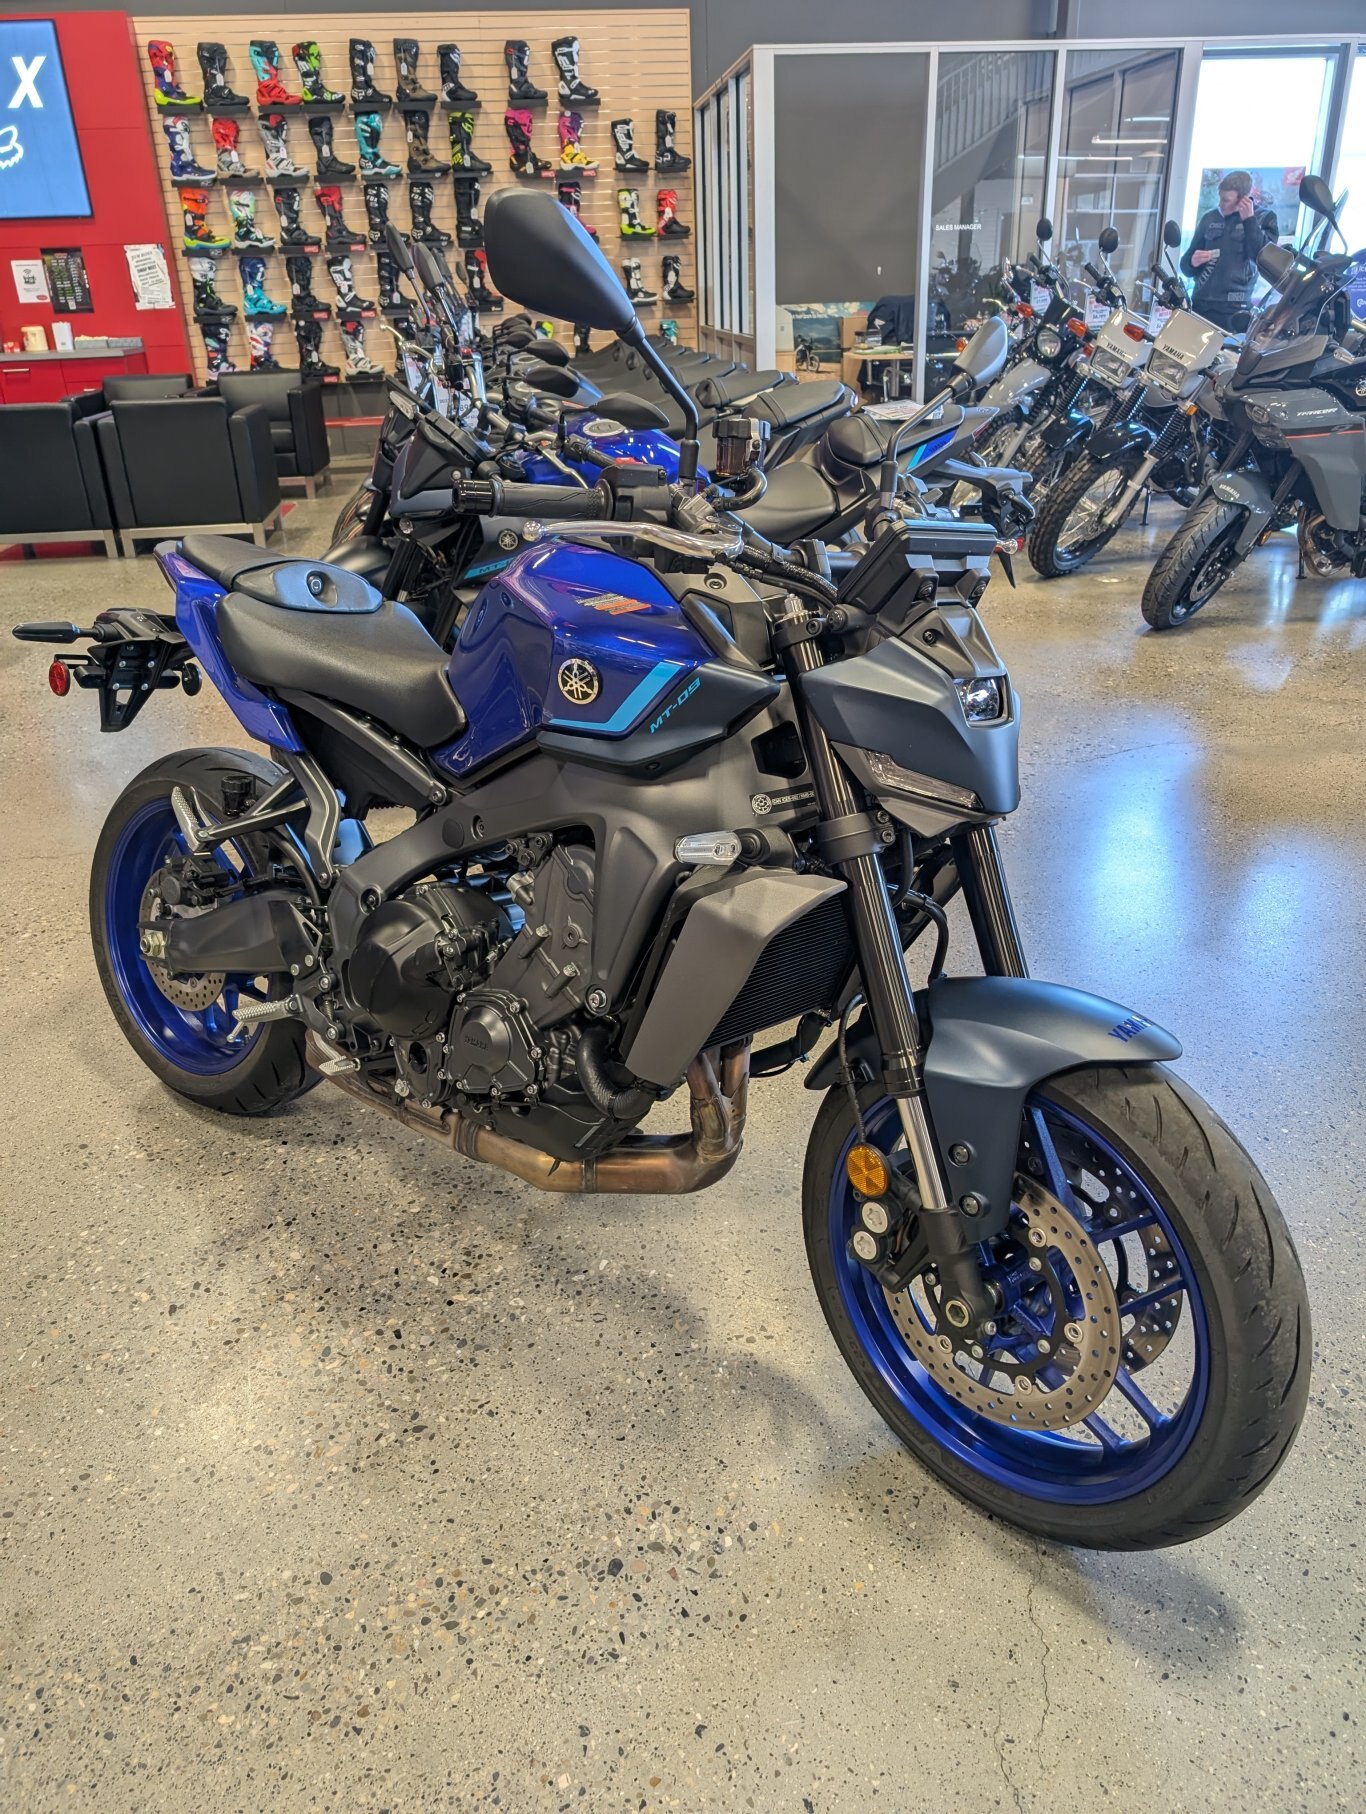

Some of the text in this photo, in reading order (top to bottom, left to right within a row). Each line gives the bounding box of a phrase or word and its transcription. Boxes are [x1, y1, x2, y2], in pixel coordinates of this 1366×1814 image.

[954, 223, 982, 231] MANAGER
[1106, 342, 1127, 358] YAMAHA
[1162, 343, 1185, 360] YAMAHA
[1296, 407, 1339, 417] TRACER
[649, 677, 701, 734] MT-09
